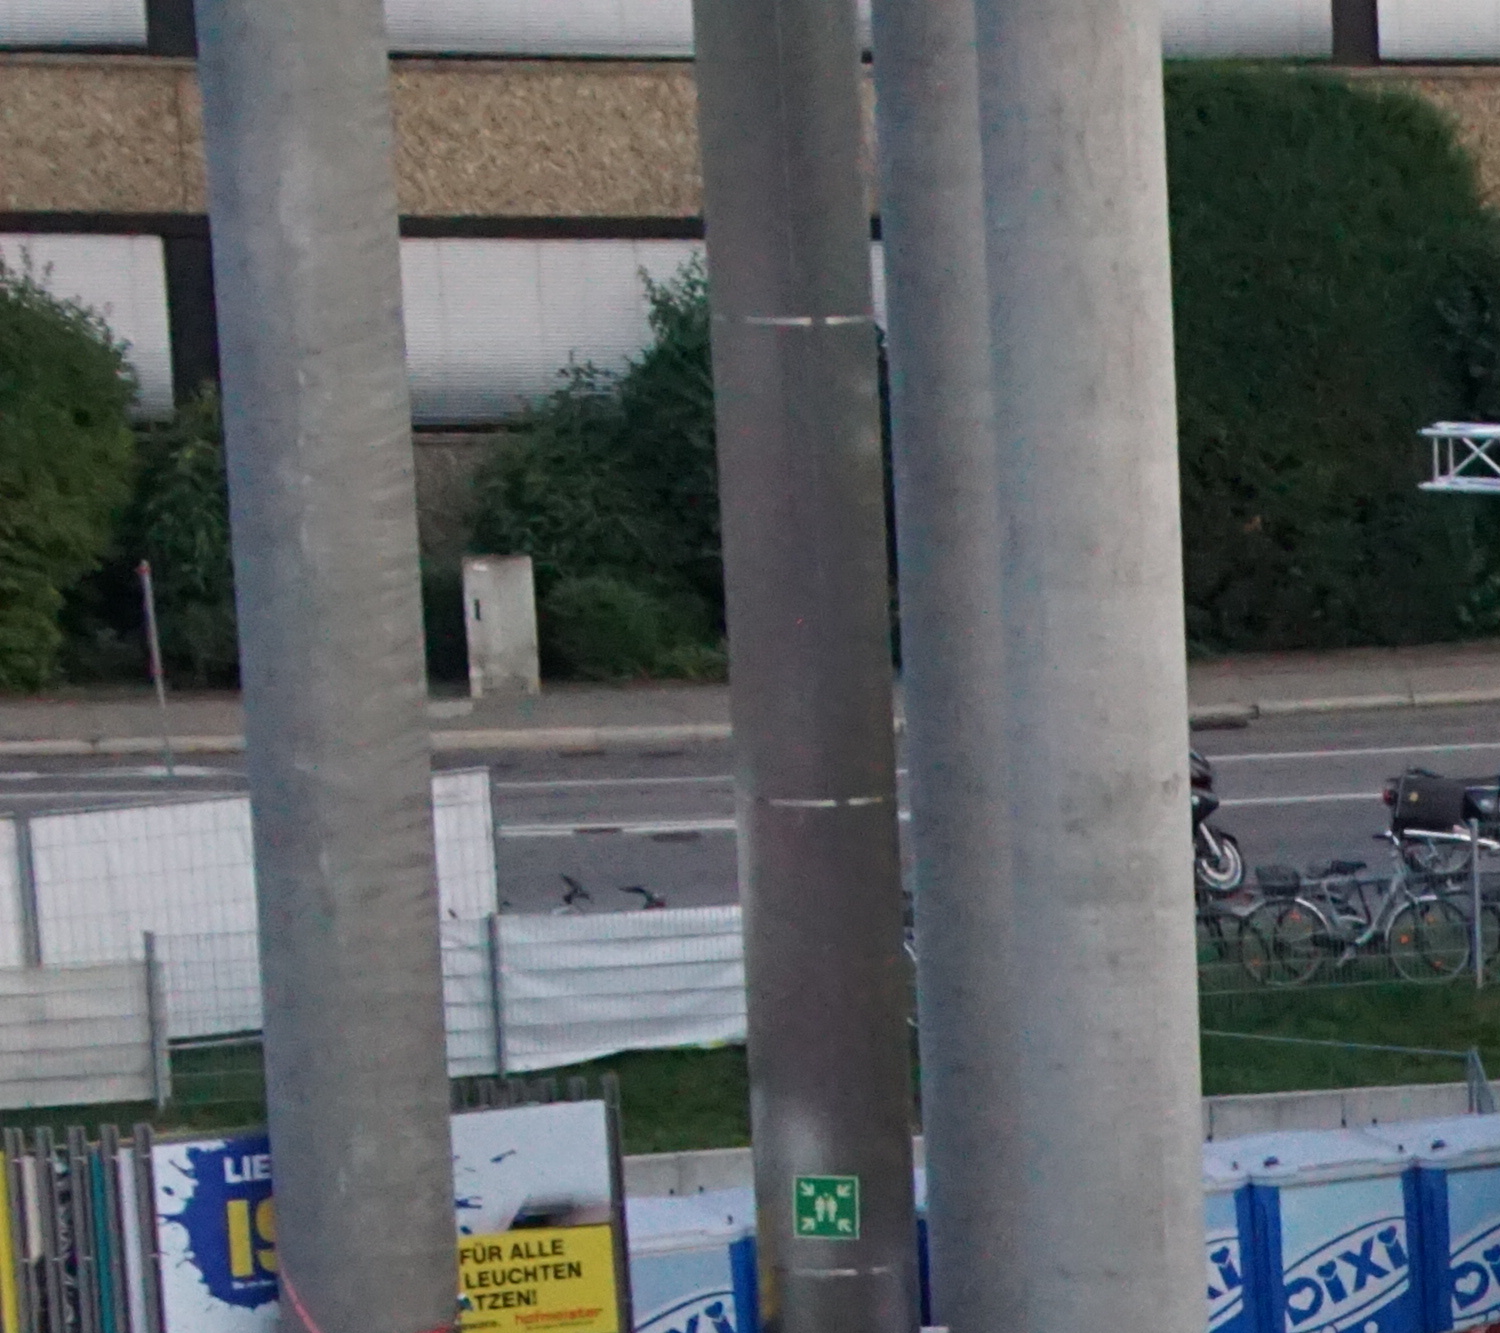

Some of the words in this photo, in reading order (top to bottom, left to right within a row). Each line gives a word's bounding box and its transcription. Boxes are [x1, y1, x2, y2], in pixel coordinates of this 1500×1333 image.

[459, 1245, 502, 1265] FÜR
[509, 1239, 563, 1261] ALLE
[465, 1261, 582, 1290] LEUCHTEN
